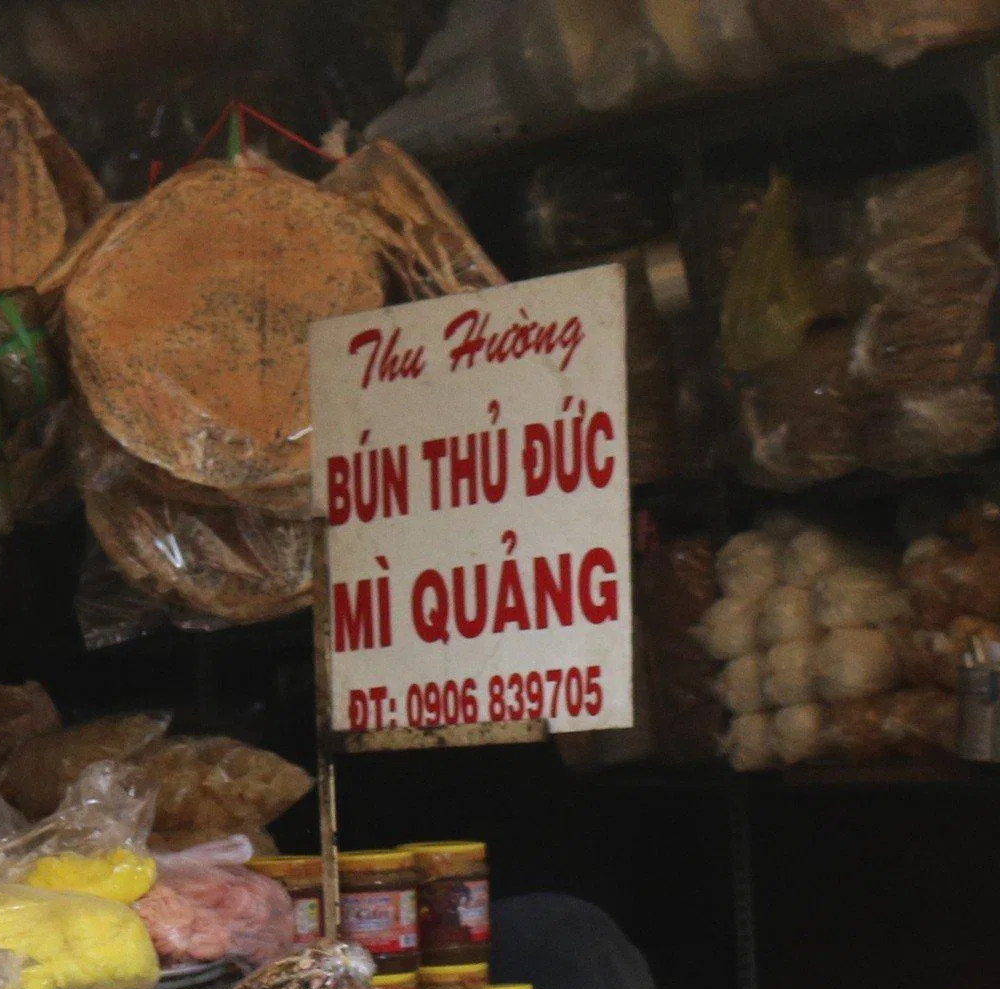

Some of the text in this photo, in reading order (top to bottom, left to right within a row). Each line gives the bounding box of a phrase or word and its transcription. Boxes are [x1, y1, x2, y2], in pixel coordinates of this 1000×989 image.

[348, 307, 585, 390] Thu Hường
[327, 395, 615, 527] BÚN THỦ ĐỨC
[333, 530, 618, 653] MÌ QUẢNG
[406, 678, 478, 729] 0906
[489, 665, 603, 723] 839705
